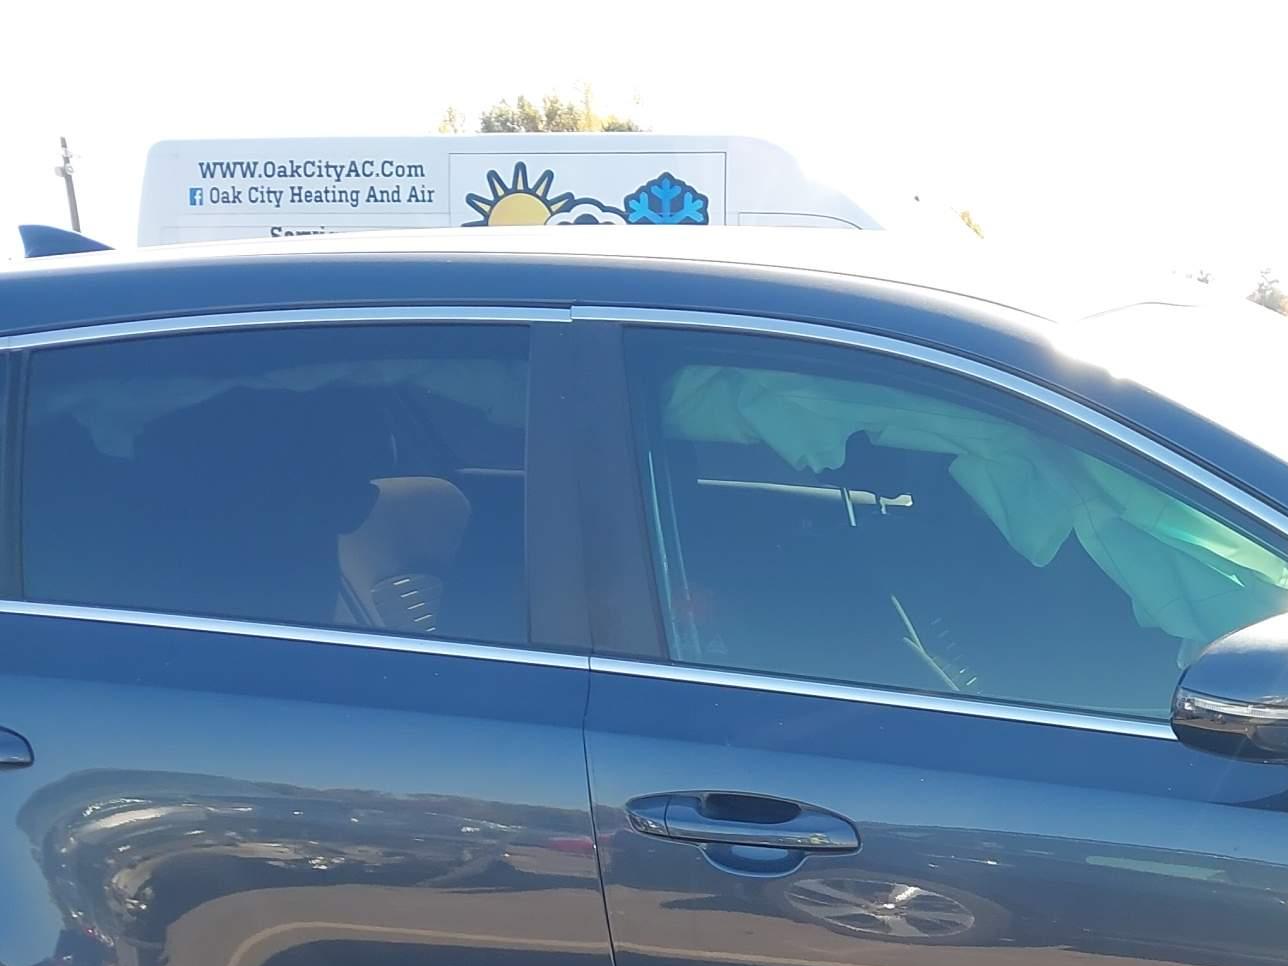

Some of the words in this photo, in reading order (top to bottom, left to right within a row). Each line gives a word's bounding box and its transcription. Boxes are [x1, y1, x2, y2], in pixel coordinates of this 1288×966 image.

[198, 159, 426, 182] WWW.OakCityAC.Com
[209, 185, 243, 204] Oak
[248, 185, 284, 208] City
[289, 184, 360, 208] Heating
[365, 184, 402, 203] And
[406, 184, 436, 203] Air
